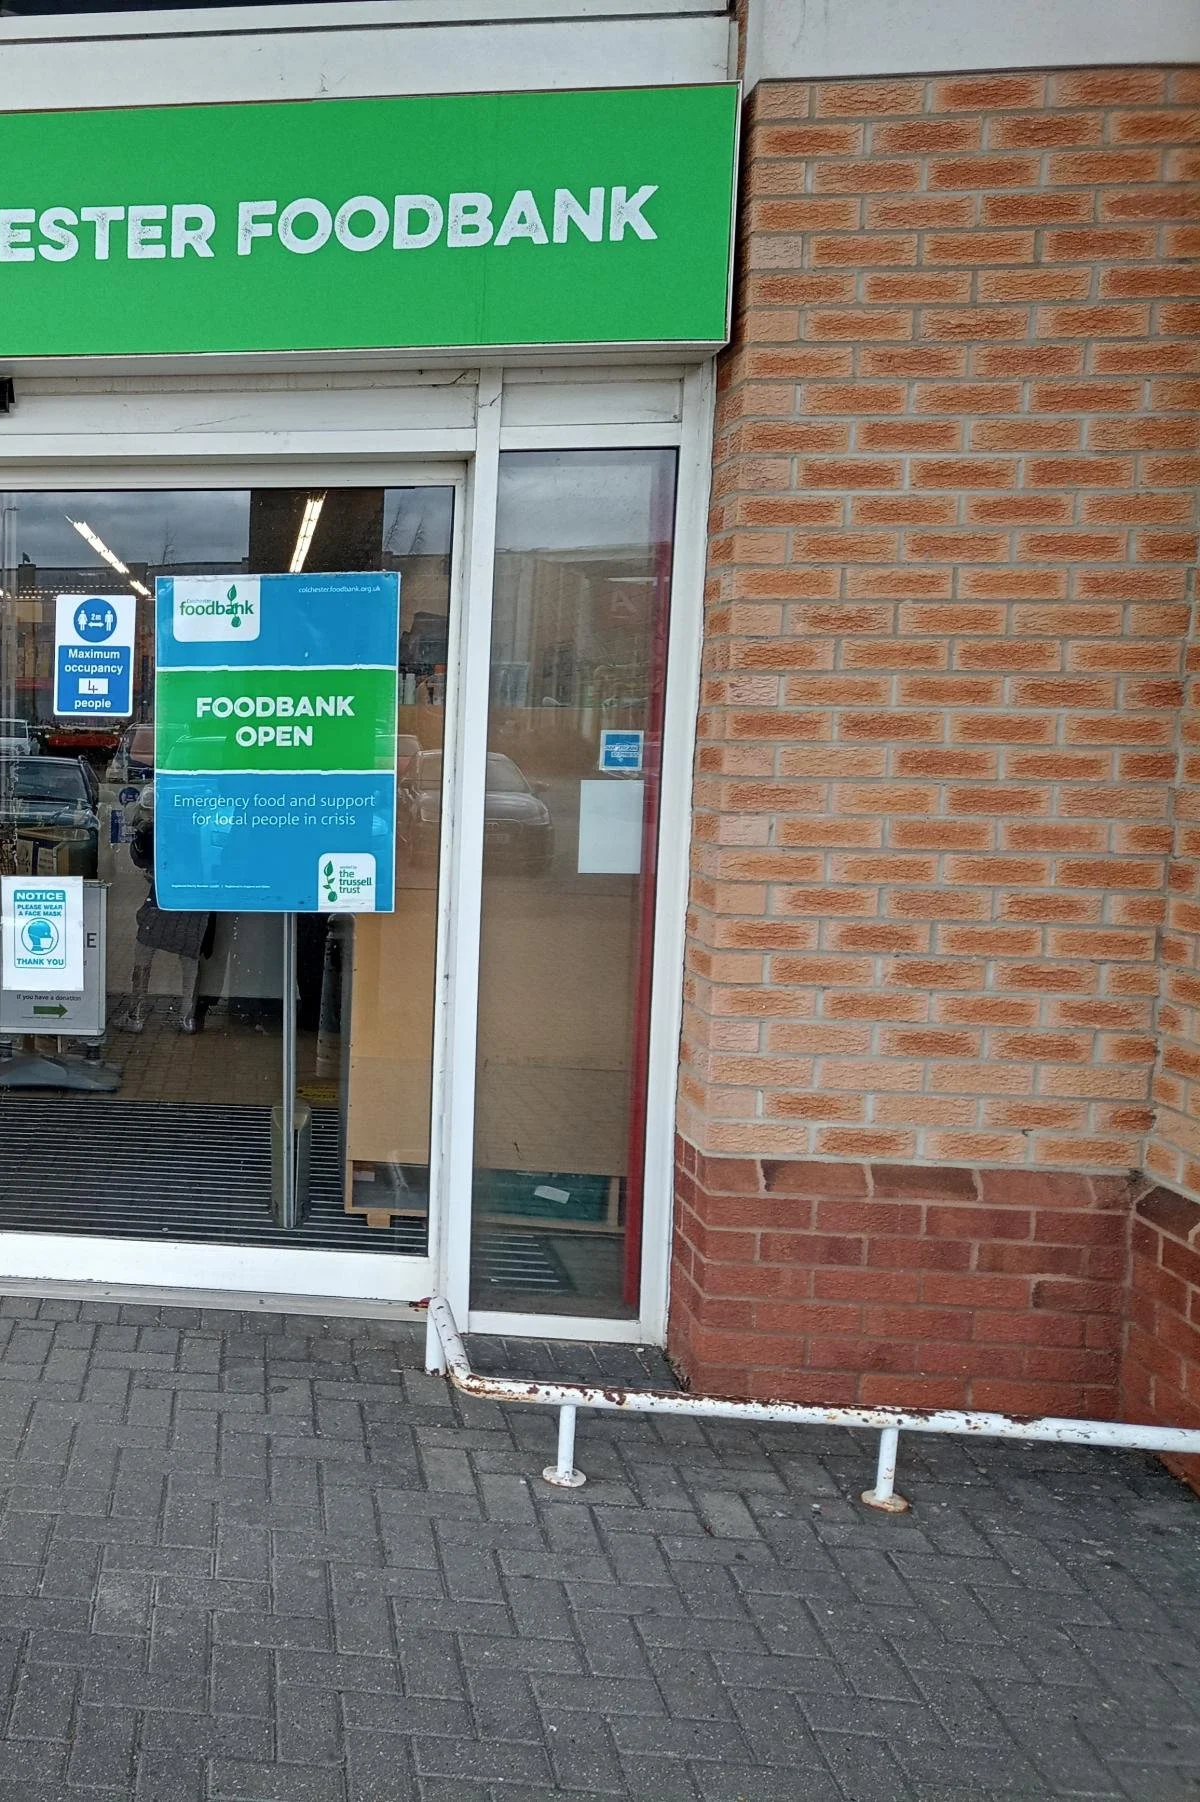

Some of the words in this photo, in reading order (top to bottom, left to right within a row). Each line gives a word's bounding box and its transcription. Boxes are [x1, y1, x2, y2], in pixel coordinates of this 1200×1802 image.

[237, 184, 660, 256] FOODBANK
[298, 585, 381, 593] colchester.foodbank.org.uk
[180, 600, 254, 616] foodbank
[90, 613, 102, 621] 2m
[68, 648, 120, 659] Maximum
[64, 664, 123, 676] occupancy
[87, 679, 99, 694] 4
[74, 698, 112, 710] people
[196, 695, 356, 718] FOODBANK
[235, 725, 313, 747] OPEN
[174, 794, 250, 810] Emergency
[253, 794, 285, 807] food
[290, 794, 316, 807] and
[320, 794, 376, 810] support
[192, 812, 211, 825] for
[215, 812, 247, 825] local
[251, 812, 299, 828] people
[304, 812, 317, 825] in
[321, 812, 356, 826] crisis
[339, 869, 355, 878] the
[339, 877, 373, 886] trussell
[339, 886, 361, 894] trust
[16, 892, 64, 900] NOTICE
[46, 958, 64, 966] YOU
[55, 993, 81, 1001] donation
